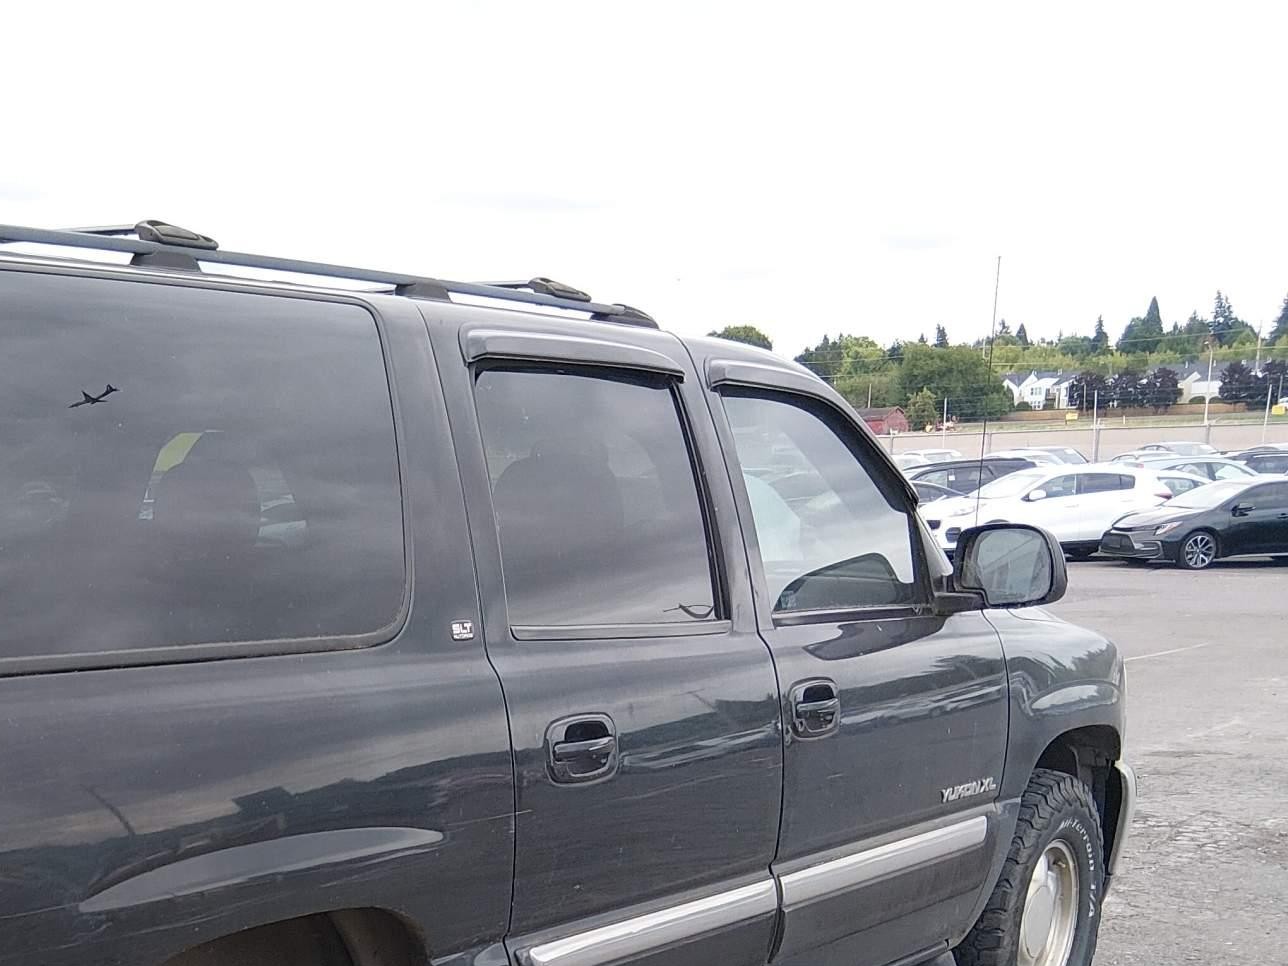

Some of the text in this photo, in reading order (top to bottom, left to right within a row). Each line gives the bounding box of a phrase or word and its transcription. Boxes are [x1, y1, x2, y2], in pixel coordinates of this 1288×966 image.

[452, 623, 472, 634] SLT
[941, 777, 997, 802] YUKON XL
